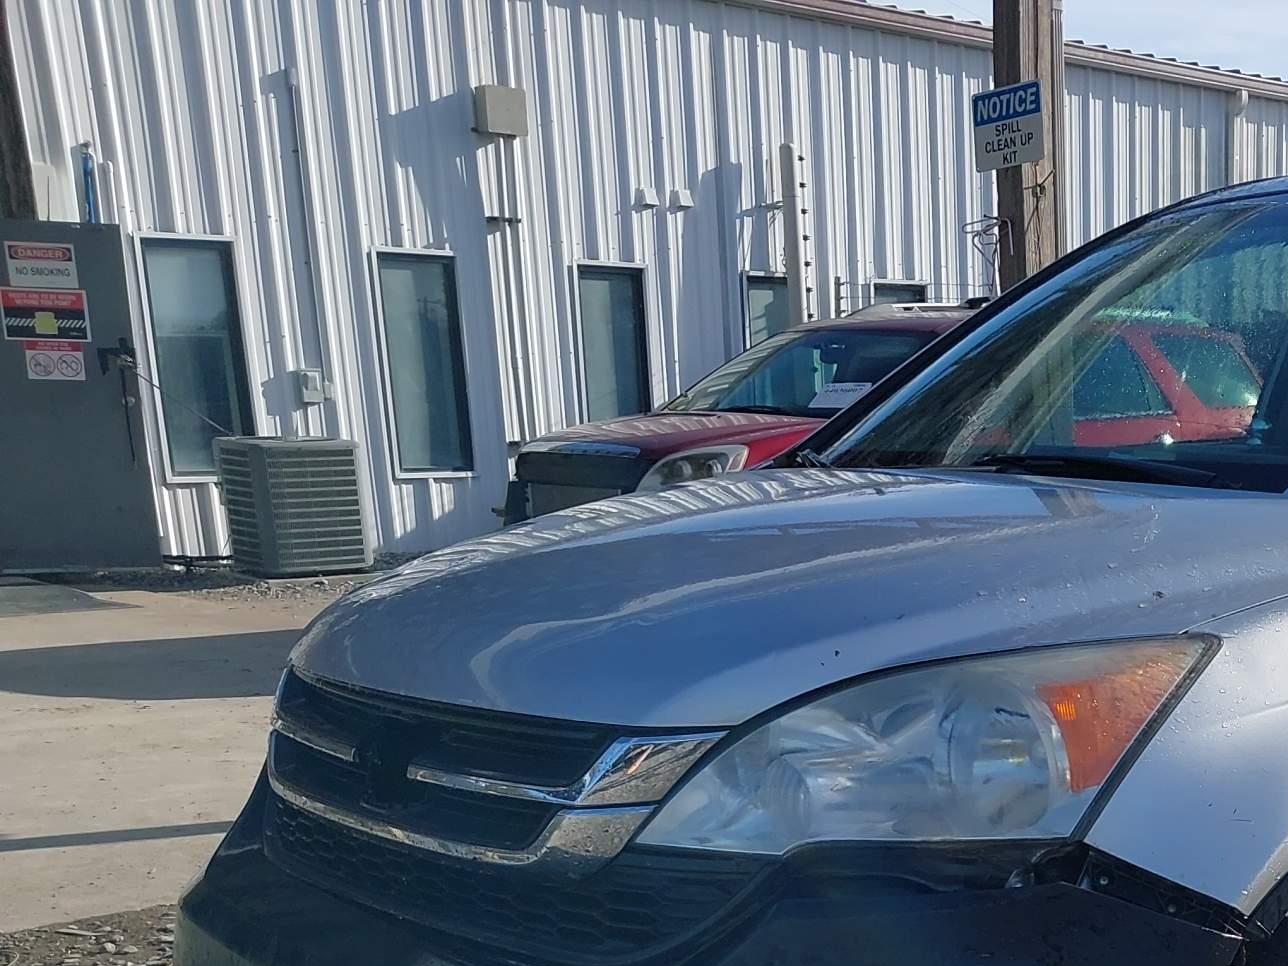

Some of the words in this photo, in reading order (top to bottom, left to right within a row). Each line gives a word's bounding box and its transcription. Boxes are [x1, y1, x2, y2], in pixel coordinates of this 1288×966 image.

[977, 87, 1037, 122] NOTICE
[995, 120, 1022, 137] SPILL
[985, 136, 1017, 154] CLEAN
[1020, 132, 1034, 146] UP
[1002, 151, 1018, 165] KIT
[16, 247, 64, 258] DANGER
[15, 266, 28, 276] NO
[31, 267, 71, 277] SMOKING
